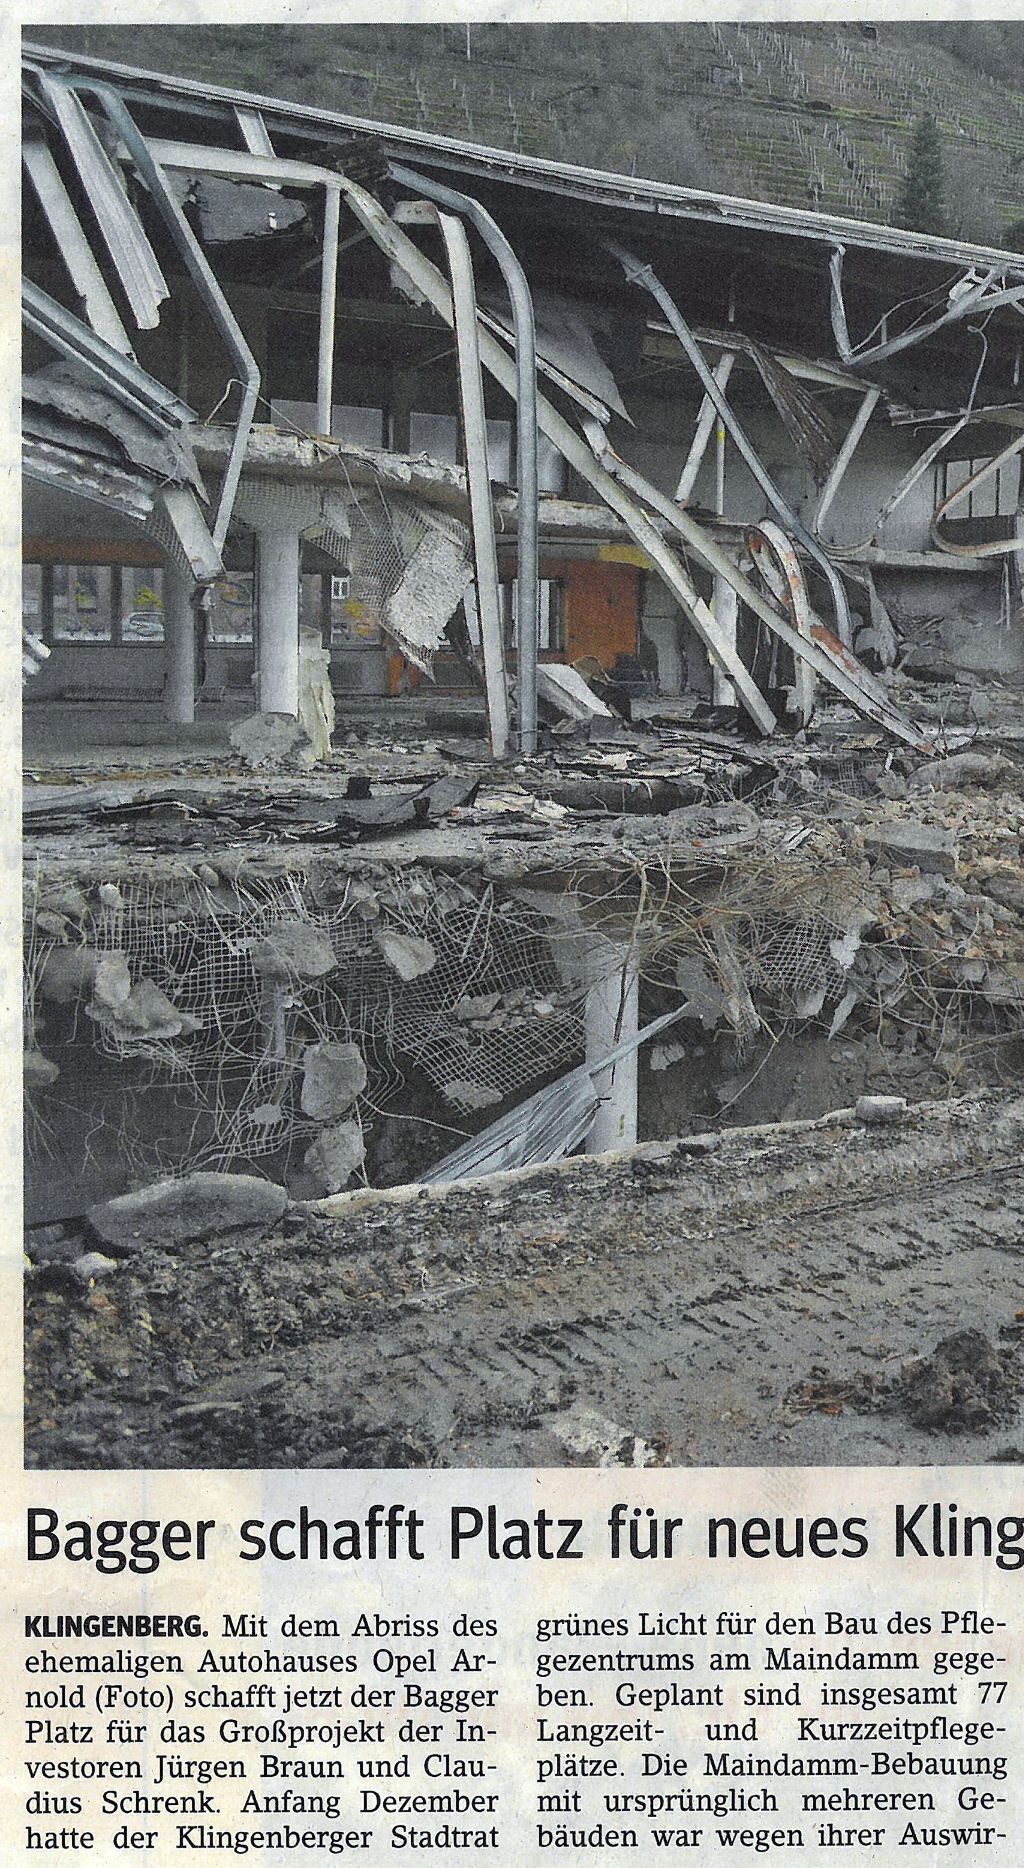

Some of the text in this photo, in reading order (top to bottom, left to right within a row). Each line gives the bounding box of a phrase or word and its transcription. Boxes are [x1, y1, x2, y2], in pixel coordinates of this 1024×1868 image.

[27, 1507, 216, 1575] Bagger
[239, 1504, 425, 1561] schafft
[451, 1504, 584, 1560] Platz
[607, 1503, 683, 1560] für
[708, 1517, 869, 1559] neues
[24, 1613, 498, 1638] KLINGENBERG. Mit dem Abriss des
[535, 1610, 1007, 1642] grünes Licht für den Bau des Pfle-
[25, 1648, 497, 1679] ehemaligen Autohauses Opel Ar-
[536, 1646, 1007, 1678] gezentrums am Maindamm gege-
[25, 1684, 499, 1714] nold (Foto) schafft jetzt der Bagger
[535, 1681, 1008, 1712] ben. Geplant sind insgesamt 77
[25, 1718, 497, 1749] Platz für das Großprojekt der In-
[536, 1715, 1006, 1748] Langzeit- und Kurzzeitpflege-
[24, 1753, 497, 1784] vestoren Jürgen Braun und Clau-
[536, 1751, 1008, 1783] plätze. Die Maindamm-Bebauung
[25, 1789, 499, 1819] dius Schrenk. Anfang Dezember
[536, 1786, 1007, 1818] mit ursprünglich mehreren Ge-
[25, 1824, 499, 1855] hatte der Klingenberger Stadtrat
[536, 1822, 1007, 1853] bäuden war wegen ihrer Auswir-
